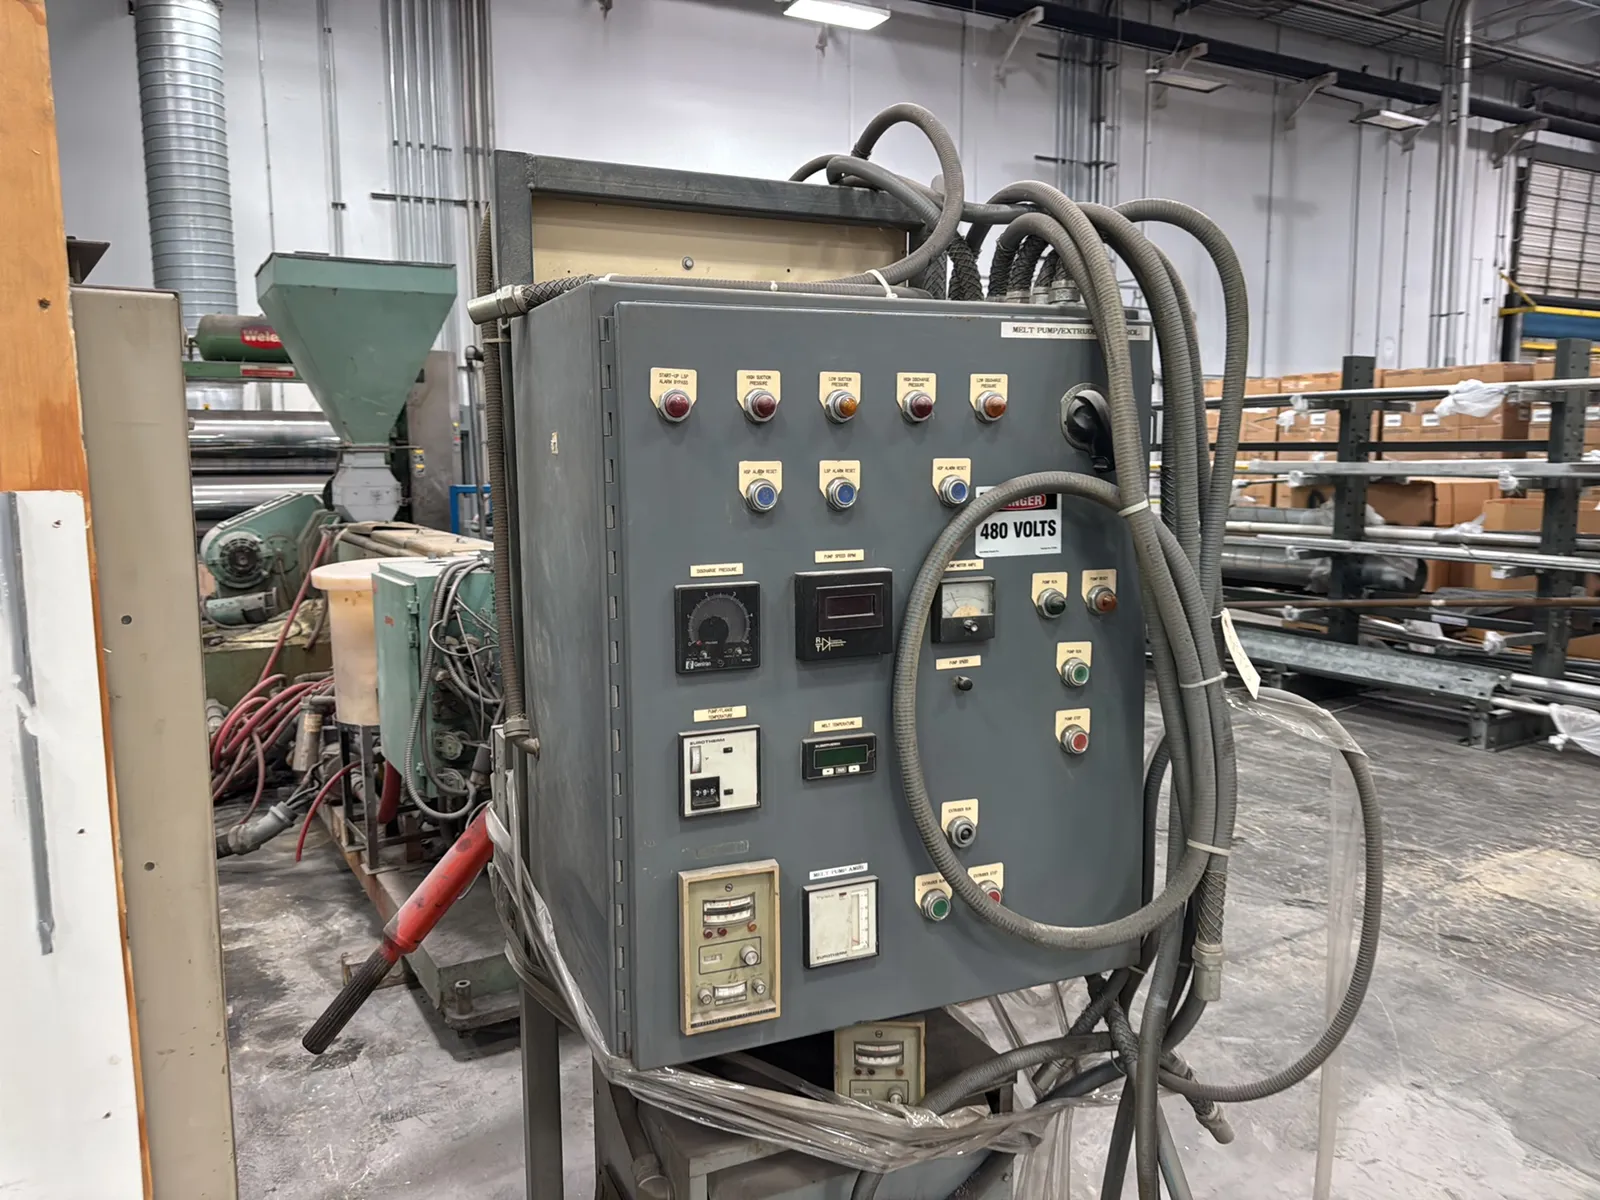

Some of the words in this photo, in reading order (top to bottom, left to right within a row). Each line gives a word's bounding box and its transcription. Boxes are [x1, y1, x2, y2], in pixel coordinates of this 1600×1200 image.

[1012, 326, 1034, 334] MELT
[1008, 493, 1043, 506] NGER
[980, 522, 1008, 540] 480
[1013, 519, 1057, 538] VOLTS
[690, 738, 726, 746] EUROTHERM
